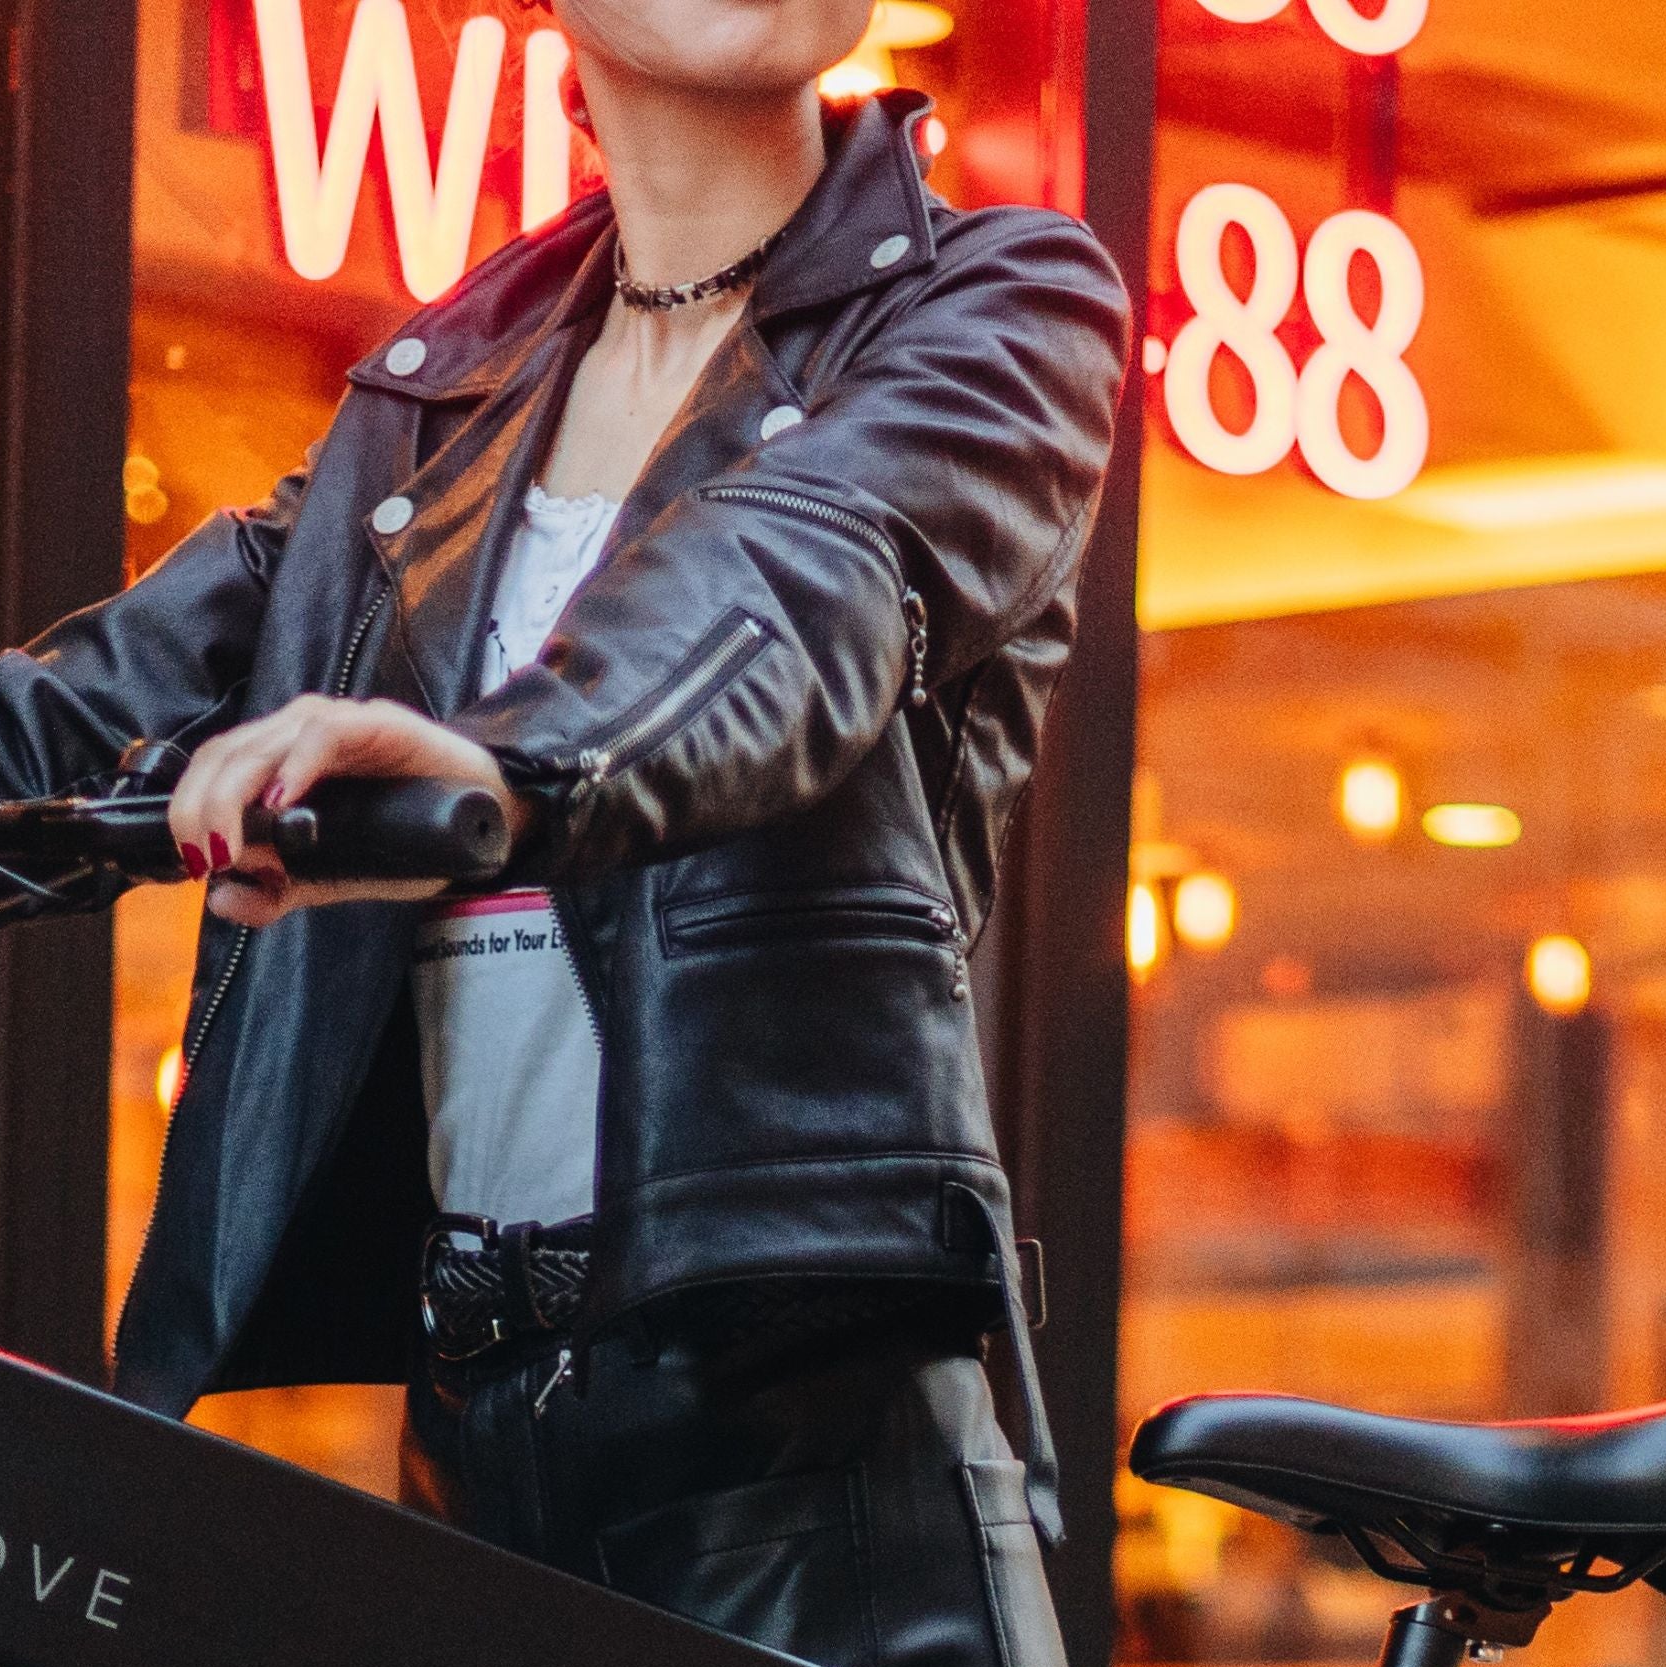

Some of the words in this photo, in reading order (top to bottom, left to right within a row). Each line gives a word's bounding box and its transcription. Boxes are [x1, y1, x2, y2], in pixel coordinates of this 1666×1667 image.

[1142, 183, 1430, 500] 88
[489, 932, 510, 954] for
[514, 928, 546, 951] Your
